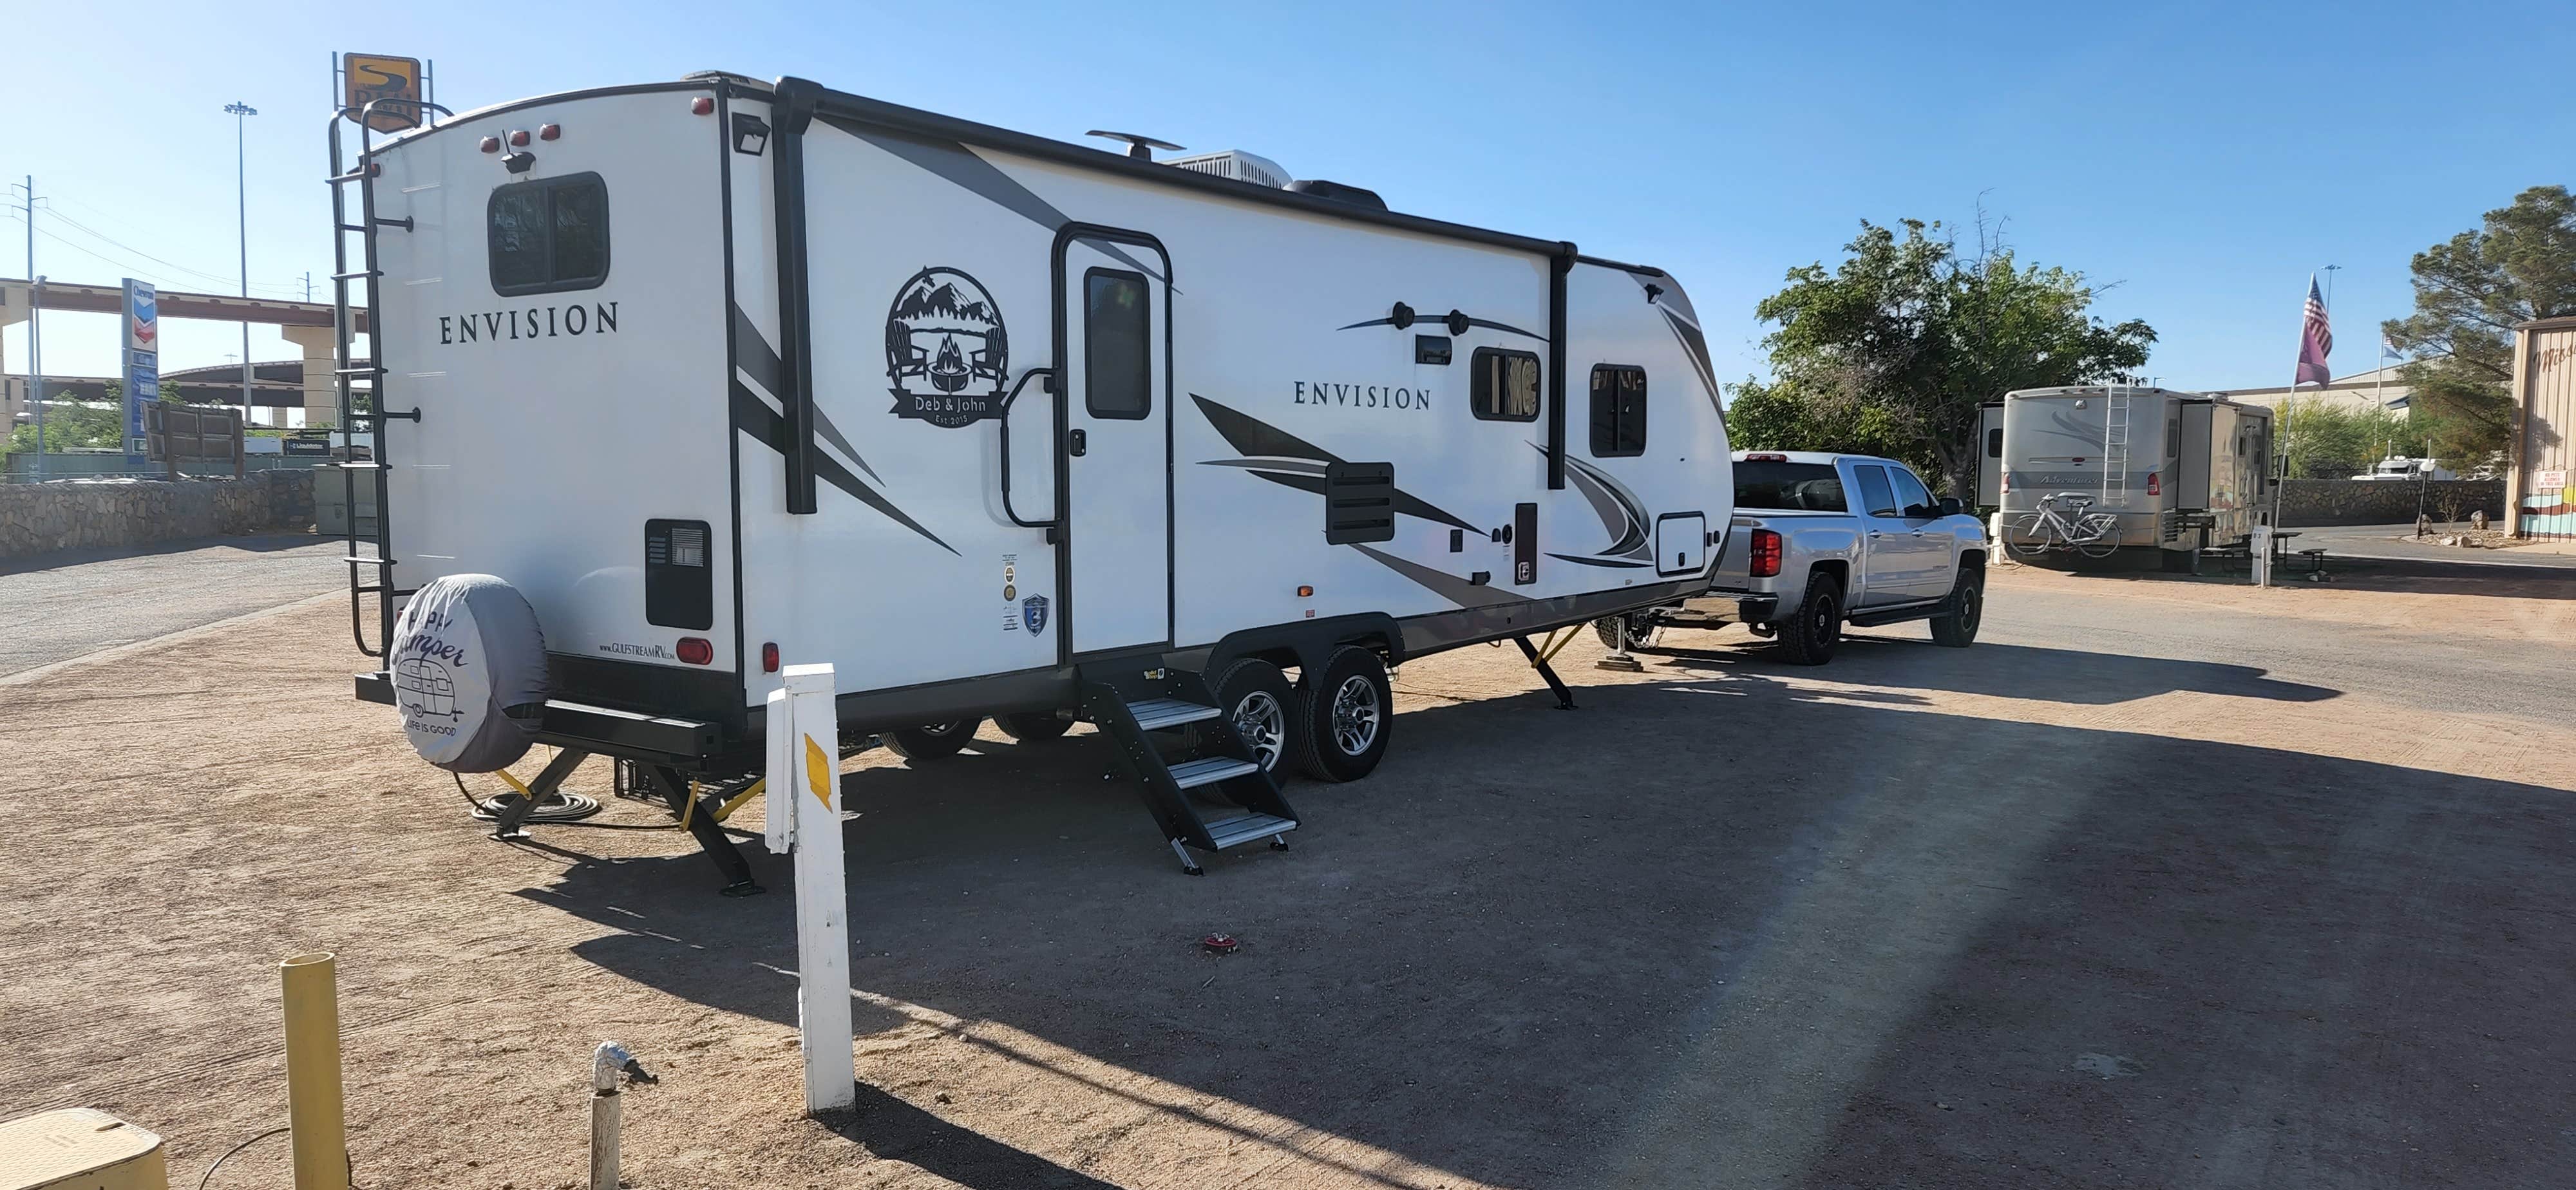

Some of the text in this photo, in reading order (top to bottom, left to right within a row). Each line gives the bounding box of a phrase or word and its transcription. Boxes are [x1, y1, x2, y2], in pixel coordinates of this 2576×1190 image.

[439, 301, 618, 345] ENVISION
[1294, 381, 1430, 410] ENVISION
[915, 397, 986, 413] Deb & John
[935, 415, 947, 424] Est
[2040, 475, 2098, 485] Adventurer
[430, 724, 457, 737] GOOD
